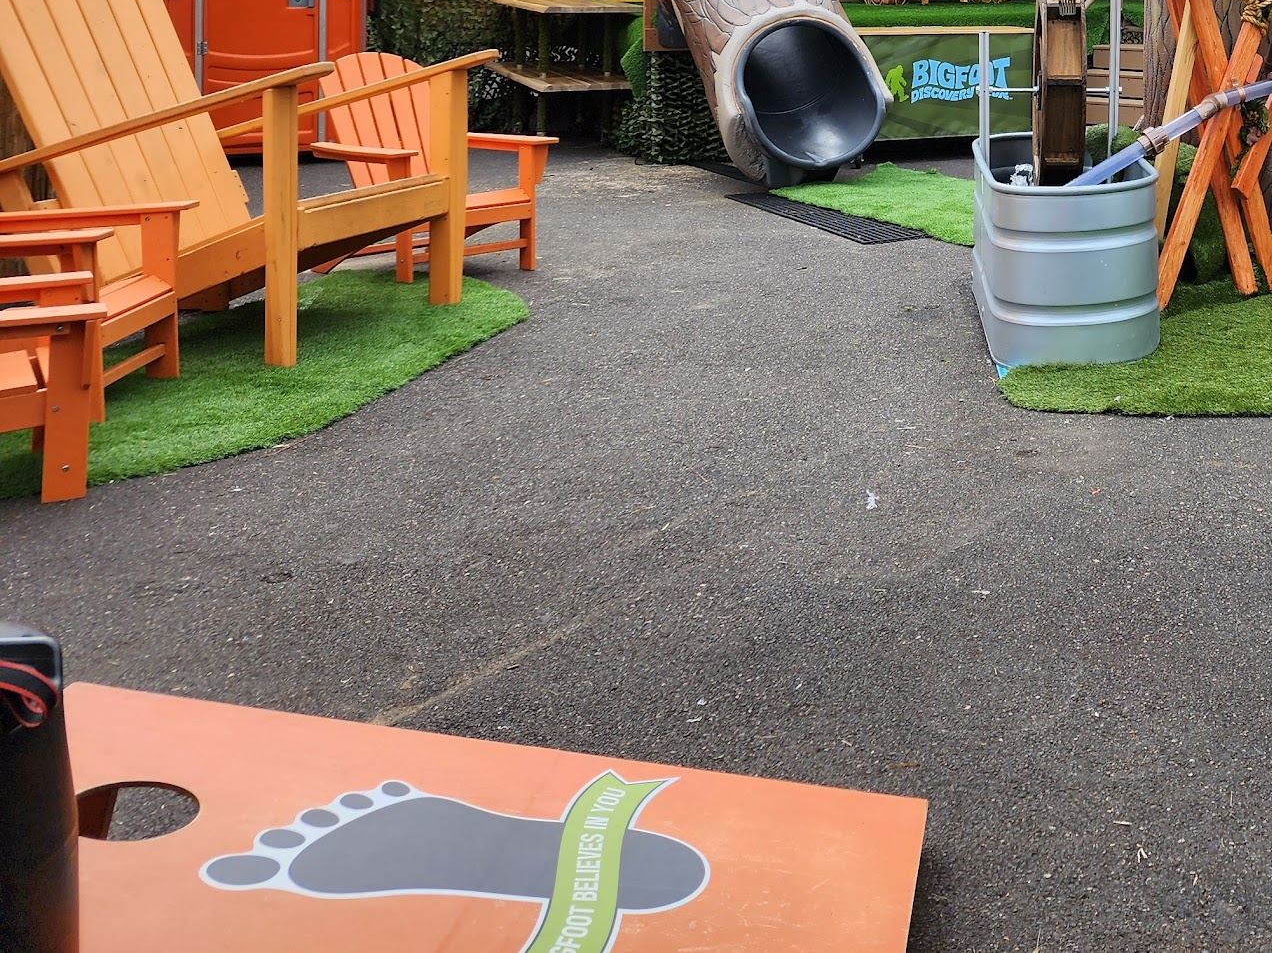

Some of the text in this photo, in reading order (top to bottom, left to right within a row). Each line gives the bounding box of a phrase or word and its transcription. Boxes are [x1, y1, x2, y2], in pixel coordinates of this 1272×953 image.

[910, 86, 975, 104] DISCOVERY
[590, 787, 626, 812] YOU
[584, 816, 610, 830] IN
[572, 833, 605, 902] BELIEVES
